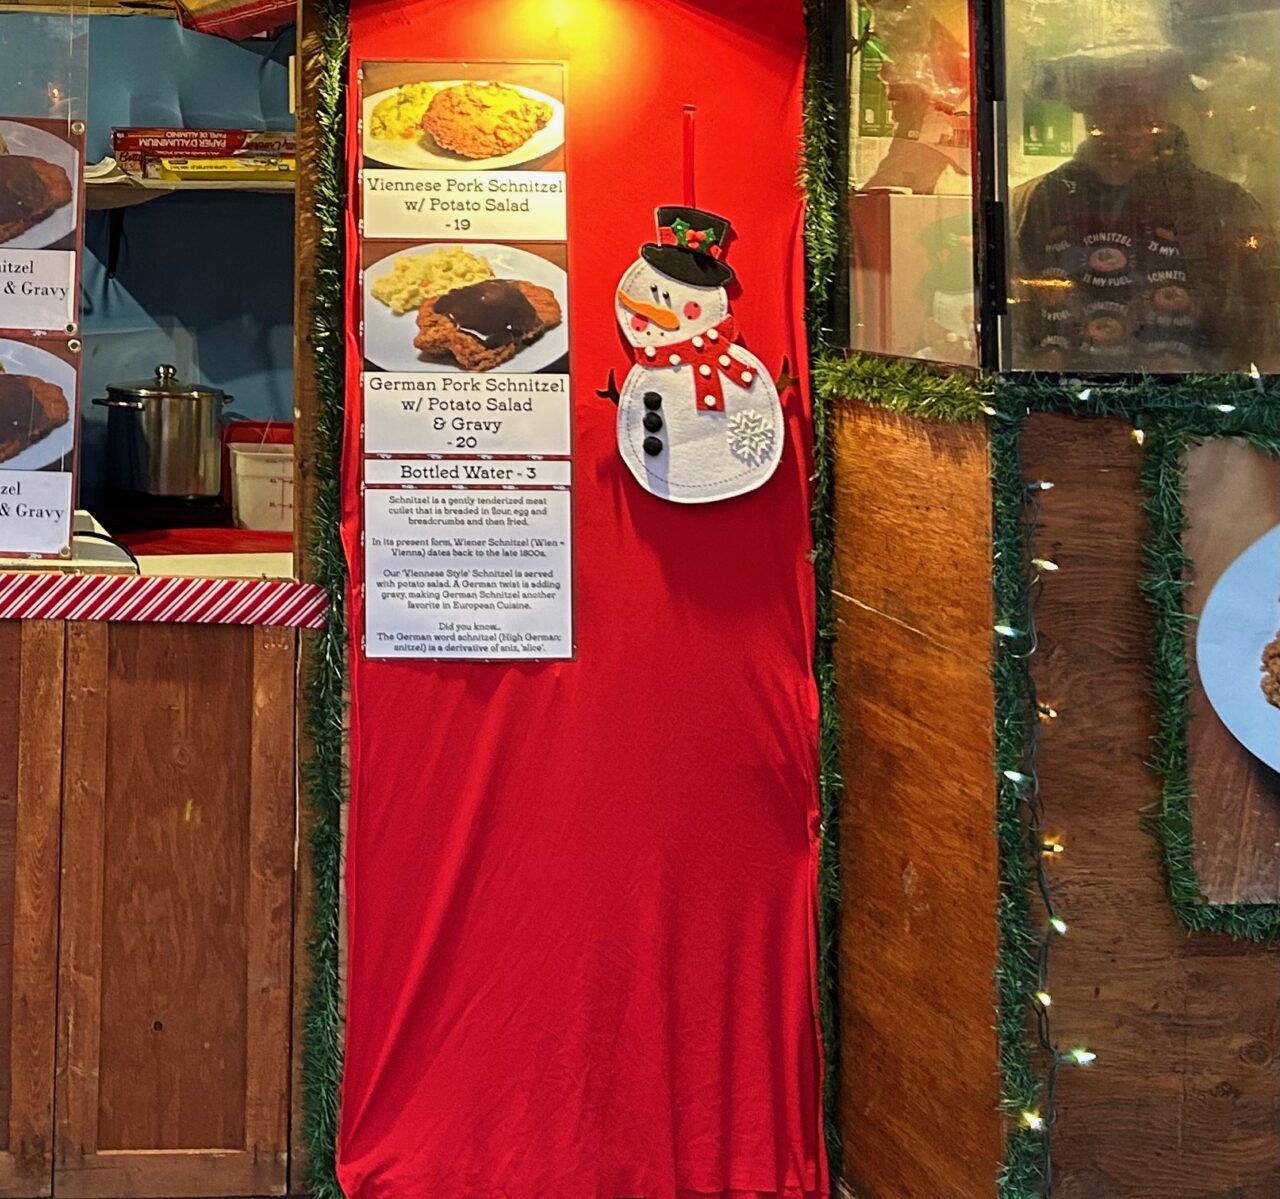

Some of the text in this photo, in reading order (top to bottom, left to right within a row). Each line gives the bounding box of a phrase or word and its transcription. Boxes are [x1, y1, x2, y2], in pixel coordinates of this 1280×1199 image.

[199, 139, 226, 147] PAPIER
[368, 179, 562, 192] Viennese Pork Schnitzel
[404, 199, 529, 212] w/ Potato Salad
[4, 280, 16, 294] &
[22, 282, 69, 300] Gravy
[370, 378, 564, 392] German Pork Schnitzel
[402, 398, 532, 412] w/ Potato Salad
[434, 419, 502, 433] & Gravy
[400, 466, 536, 480] Bottled Water 3
[389, 496, 429, 504] Schnitzel
[449, 497, 475, 507] gently
[478, 497, 523, 505] tenderized
[16, 504, 64, 523] Gravy
[389, 507, 413, 515] cutlet
[416, 507, 432, 515] that
[435, 507, 442, 515] is
[444, 507, 478, 515] breaded
[481, 507, 489, 515] in
[513, 509, 528, 517] egg
[409, 517, 464, 525] breadcrumbs
[372, 538, 381, 546] In
[397, 539, 428, 548] present
[488, 538, 528, 547] Schnitzel
[391, 549, 425, 558] Vienna)
[427, 549, 450, 557] dates
[453, 549, 473, 557] back
[486, 549, 499, 557] the
[502, 549, 518, 557] late
[472, 570, 513, 578] Schnitzel
[515, 570, 522, 578] is
[524, 570, 553, 578] served
[377, 580, 395, 588] with
[398, 581, 424, 589] potato
[453, 580, 459, 588] A
[462, 580, 497, 588] German
[531, 581, 560, 590] adding
[409, 591, 440, 600] making
[443, 591, 477, 599] German
[480, 591, 520, 599] Schnitzel
[522, 591, 555, 599] another
[408, 601, 440, 609] favorite
[453, 602, 495, 610] European
[396, 633, 431, 641] German
[434, 633, 455, 641] word
[458, 633, 496, 641] schnitzel
